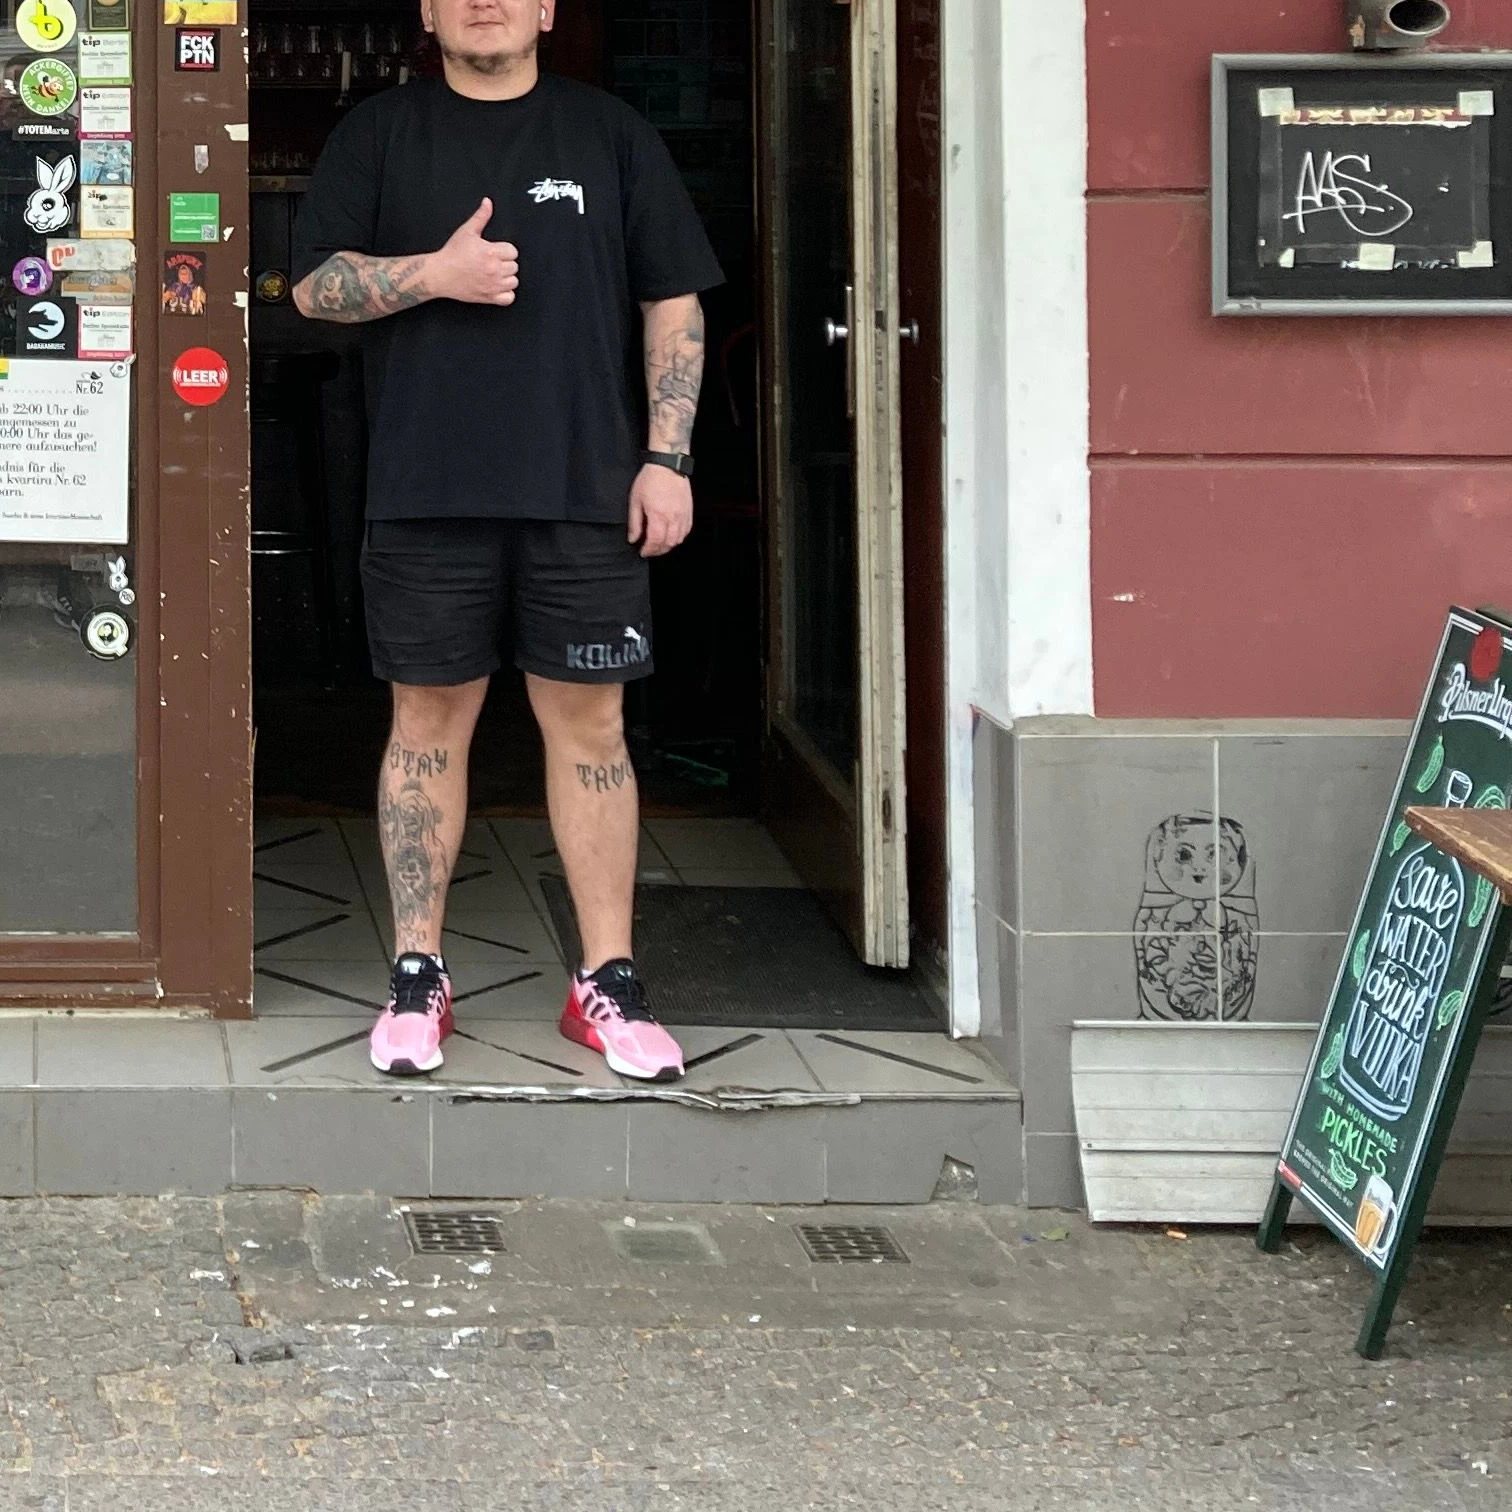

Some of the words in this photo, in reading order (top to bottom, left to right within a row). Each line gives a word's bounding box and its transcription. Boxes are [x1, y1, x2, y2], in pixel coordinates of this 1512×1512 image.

[82, 35, 101, 47] tip
[180, 35, 214, 50] FCK
[180, 49, 215, 64] PTN
[22, 84, 35, 106] NEIN
[83, 89, 101, 100] tip
[83, 307, 101, 318] tip
[182, 369, 219, 384] LEER
[76, 382, 89, 395] Nr.
[89, 381, 104, 395] 62
[13, 403, 43, 416] 22:00
[46, 403, 69, 416] Uhr
[72, 404, 89, 416] die
[63, 419, 77, 428] zu
[0, 427, 24, 439] 0:00
[27, 427, 50, 439] Uhr
[53, 428, 73, 440] das
[25, 439, 98, 453] aufzusuchen!
[28, 460, 45, 473] für
[49, 461, 66, 473] die
[6, 474, 52, 486] kvartira
[55, 474, 70, 486] Nr.
[72, 475, 87, 486] 62
[1437, 662, 1493, 723] Pilsner
[1381, 912, 1446, 998] WATER
[1366, 959, 1430, 1040] drink
[1351, 1000, 1420, 1103] VODKA
[1346, 1103, 1398, 1154] HOMEMADE
[1320, 1106, 1388, 1178] PICKLES
